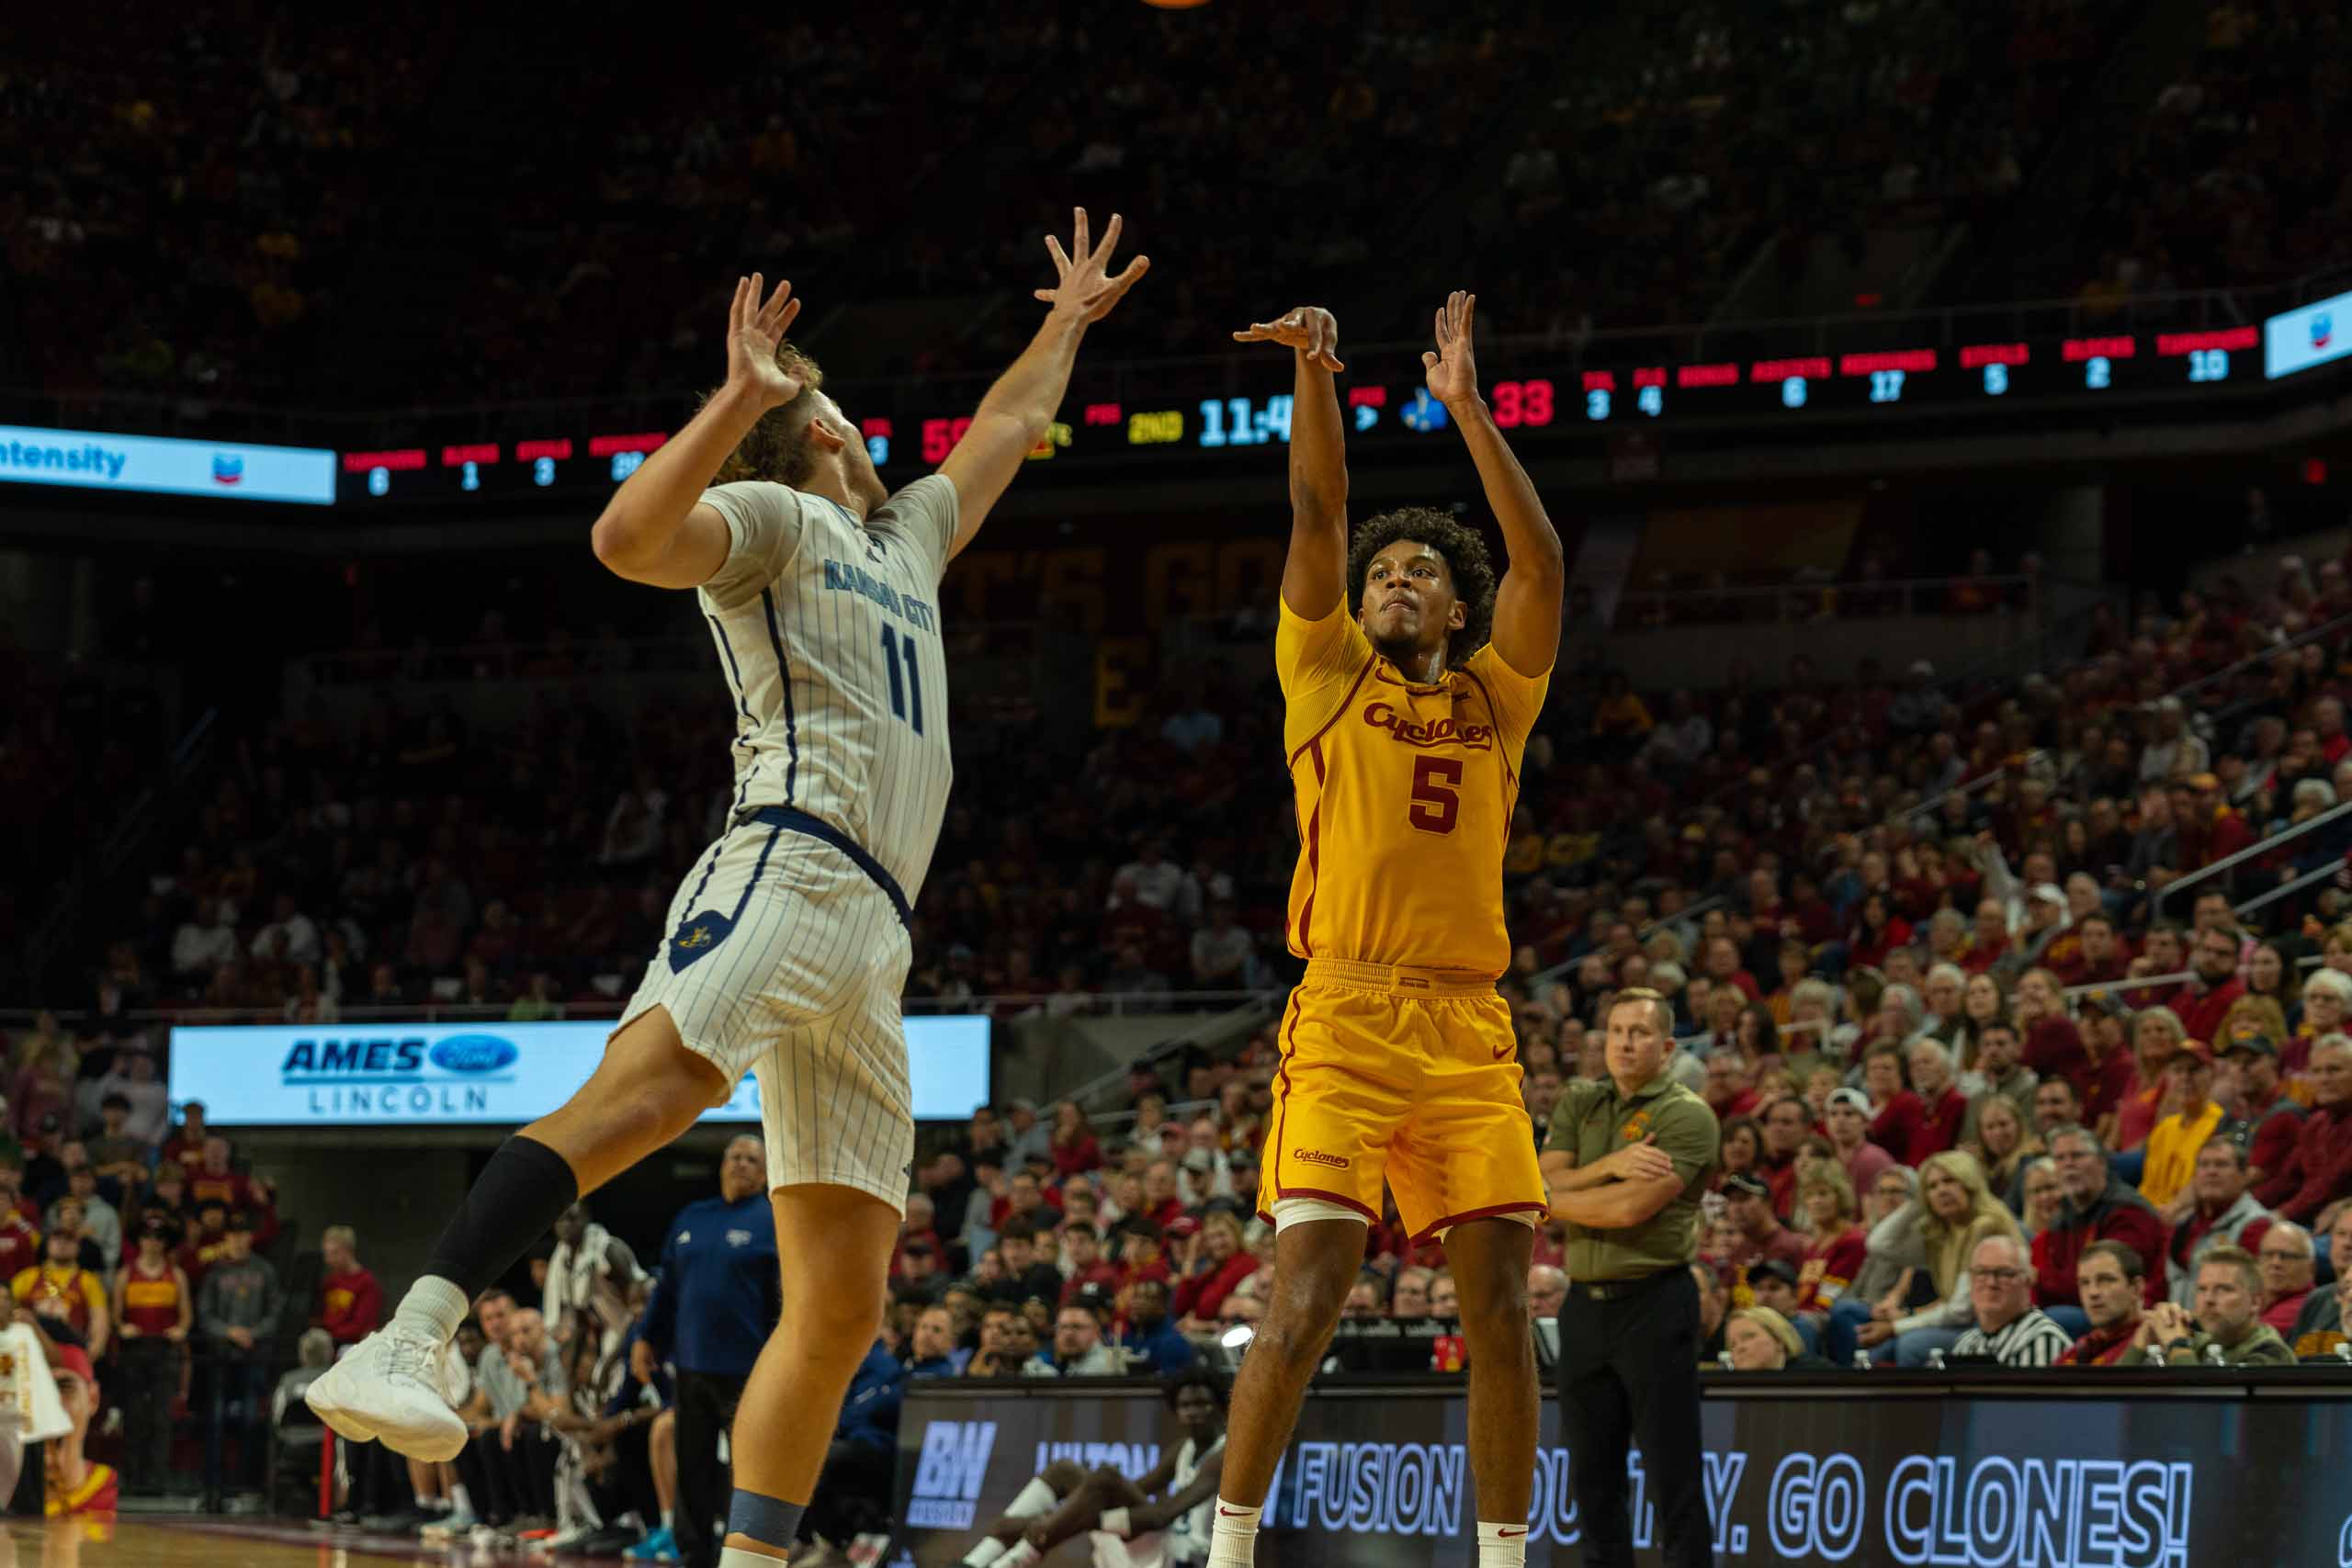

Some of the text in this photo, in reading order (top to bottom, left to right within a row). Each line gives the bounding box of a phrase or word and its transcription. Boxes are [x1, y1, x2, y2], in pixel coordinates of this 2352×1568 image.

[1491, 379, 1555, 428] 33
[900, 593, 937, 637] CITY
[881, 620, 923, 738] 11
[1408, 754, 1464, 836] 5
[282, 1038, 425, 1072] AMES
[308, 1086, 488, 1113] LINCOLN
[1294, 1148, 1351, 1168] Cyclones
[1294, 1442, 1465, 1536] FUSION
[1768, 1452, 1866, 1560] GO
[1885, 1455, 2193, 1568] CLONES!
